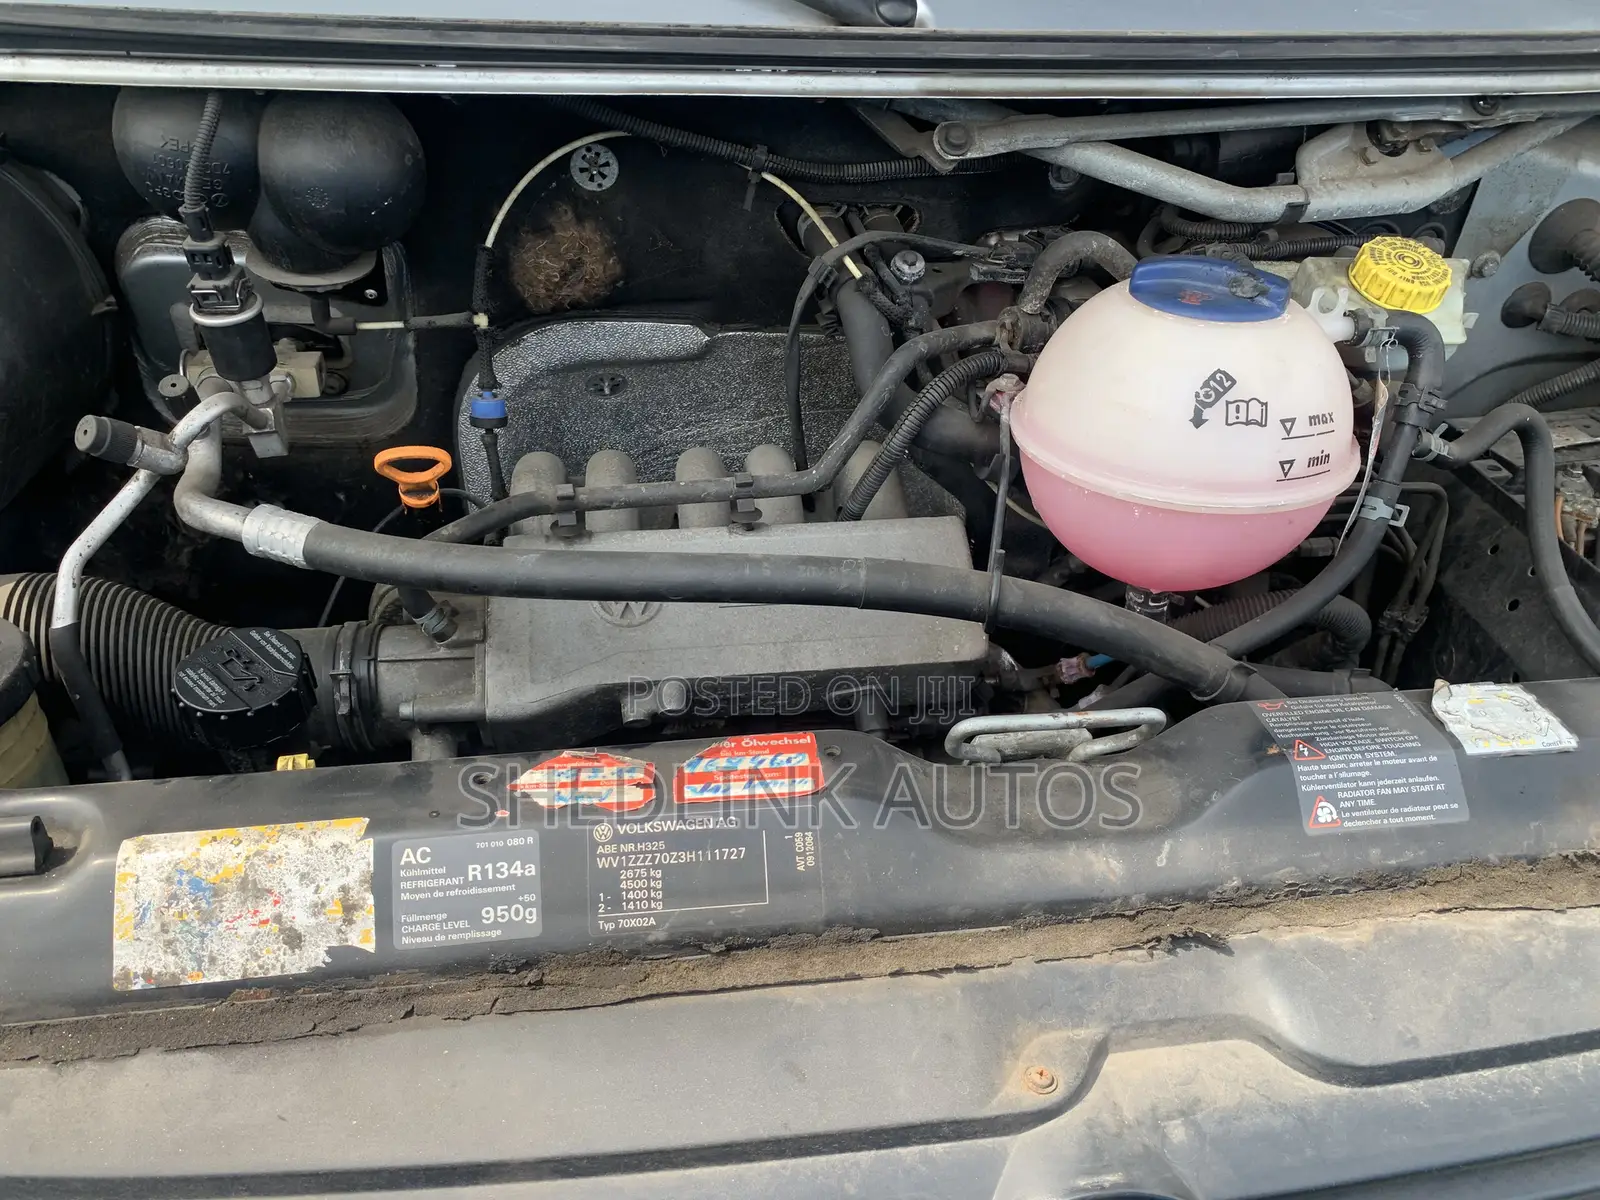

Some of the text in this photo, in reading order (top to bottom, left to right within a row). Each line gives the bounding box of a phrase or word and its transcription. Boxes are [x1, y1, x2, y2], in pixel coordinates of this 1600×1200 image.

[1308, 412, 1335, 427] max
[1307, 449, 1331, 468] min
[741, 735, 812, 748] Ölwechsel
[1375, 736, 1404, 744] SWITCH
[1324, 741, 1422, 754] ENGINE BEFORE TOUCHING
[1329, 750, 1398, 762] IGNITION SYSTEM.
[1297, 763, 1319, 772] Haute
[1299, 773, 1327, 782] toucher
[1301, 774, 1440, 792] Kühlerventilator kann jederzeit anlaufen.
[1337, 783, 1446, 799] RADIATOR FAN MAY START AT
[1339, 800, 1356, 809] ANY
[1351, 807, 1389, 817] ventilateur
[1389, 806, 1399, 814] de
[1400, 804, 1432, 813] radiateur
[1432, 802, 1449, 811] peut
[617, 816, 737, 835] VOLKSWAGEN AG
[1343, 819, 1383, 828] declencher
[1388, 816, 1404, 824] tout
[506, 837, 525, 847] 080
[526, 836, 534, 844] R
[400, 846, 432, 865] AC
[596, 844, 618, 854] ABE
[794, 832, 806, 871] AVT C059
[804, 831, 814, 867] 0912064
[596, 847, 746, 869] WV1ZZZ70Z3H111727
[400, 866, 447, 877] Kühlmittel
[468, 860, 536, 881] R134a
[619, 867, 662, 880] 2675 kg
[400, 876, 465, 889] REFRIGERANT
[619, 878, 662, 890] 4500 kg
[400, 883, 516, 901] Moyen de refroidissement
[518, 893, 536, 902] +50
[621, 889, 649, 900] 1400
[650, 888, 663, 900] kg
[622, 900, 649, 911] 1410
[650, 899, 663, 910] kg
[401, 912, 448, 923] Füllmenge
[481, 904, 537, 924] 950g
[401, 920, 471, 934] CHARGE LEVEL
[598, 916, 656, 931] Typ 70X02A
[401, 928, 502, 945] Niveau de remplissage
